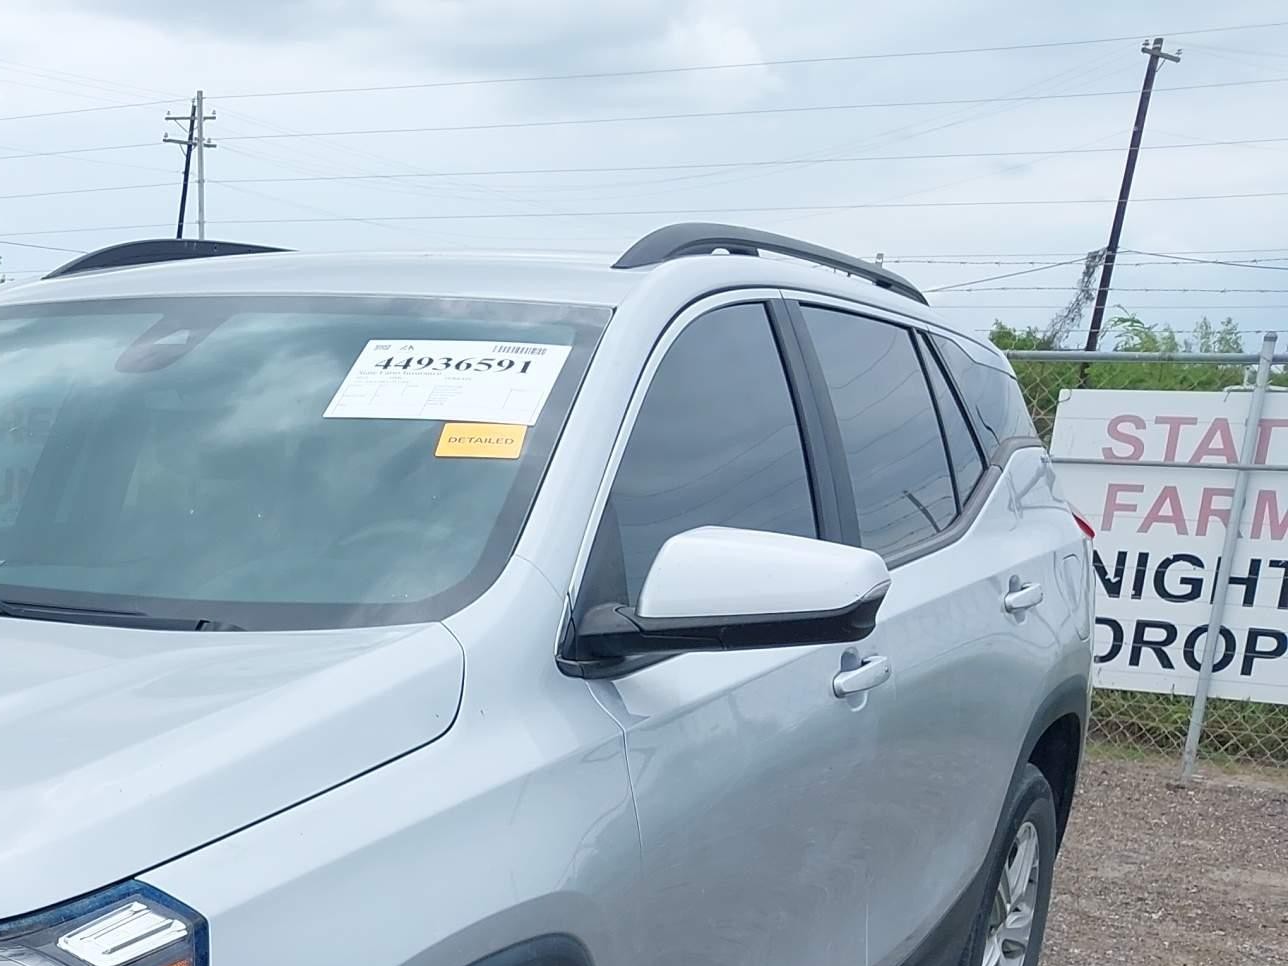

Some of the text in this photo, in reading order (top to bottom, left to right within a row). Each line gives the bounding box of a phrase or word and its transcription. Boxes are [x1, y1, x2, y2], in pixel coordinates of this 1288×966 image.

[374, 356, 532, 374] 44936591
[448, 436, 514, 445] DETAILED
[1101, 414, 1288, 465] STAT
[1100, 483, 1288, 541] FARM
[1094, 616, 1288, 676] DROP
